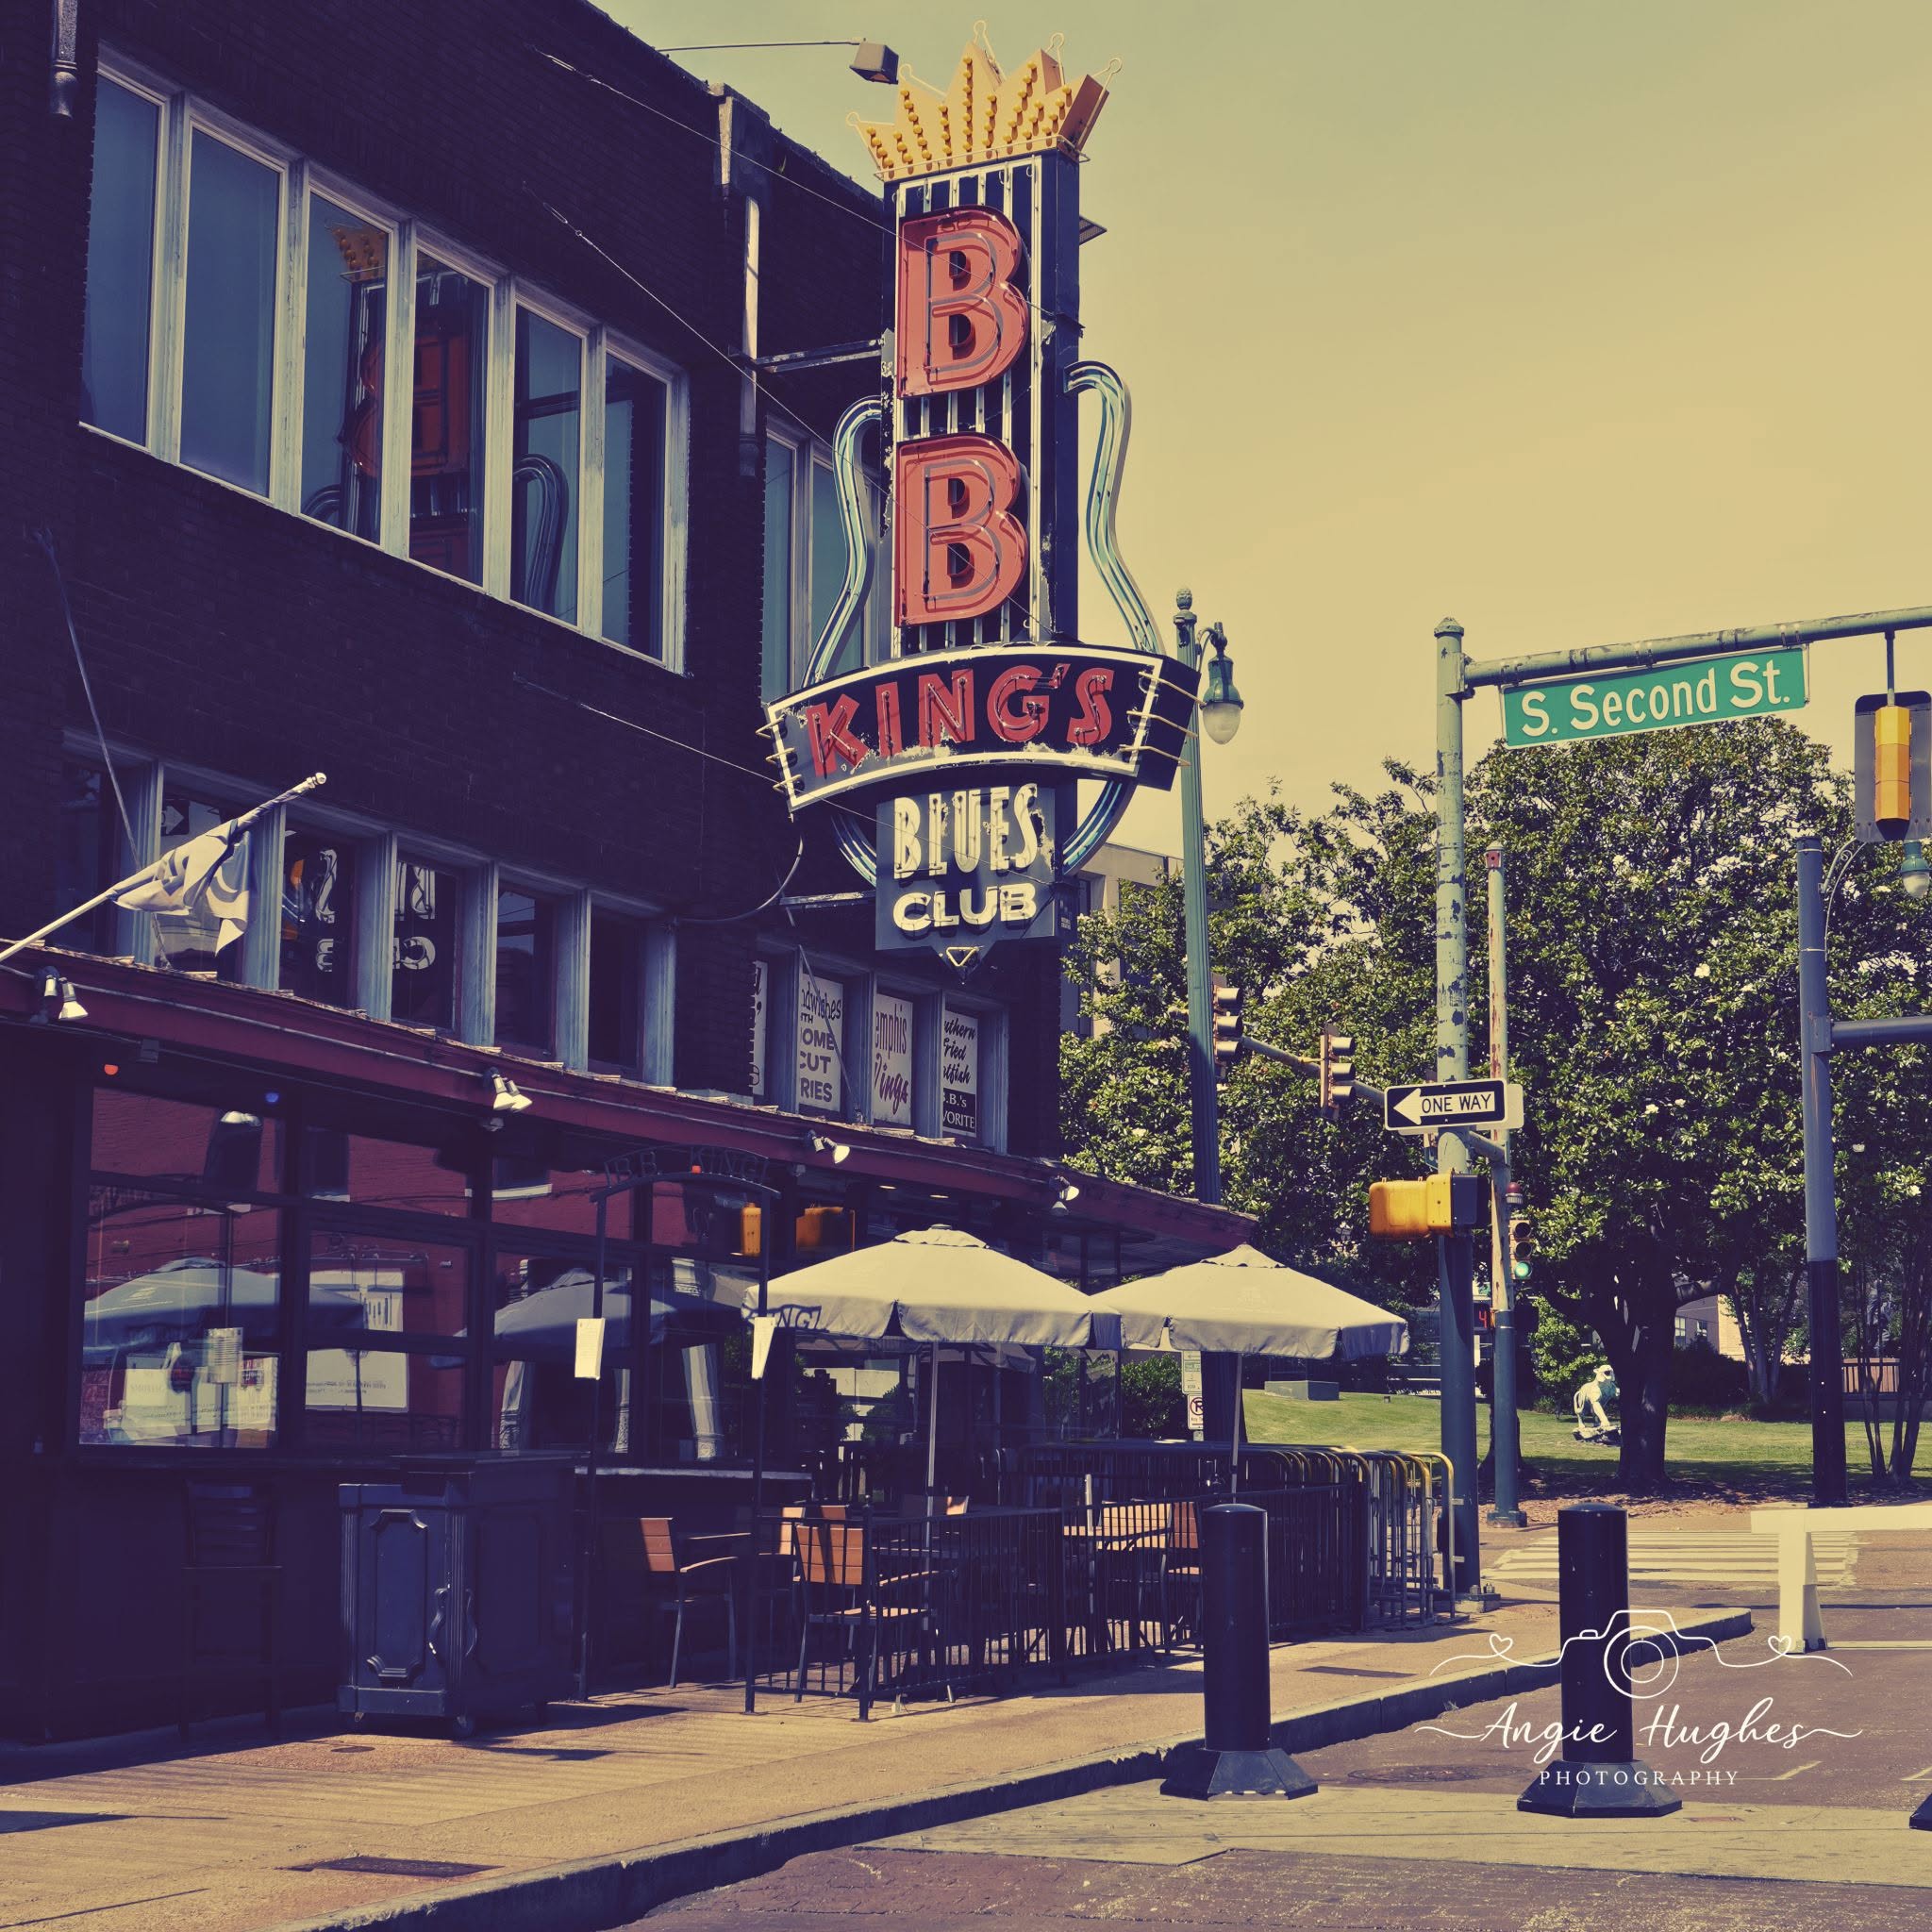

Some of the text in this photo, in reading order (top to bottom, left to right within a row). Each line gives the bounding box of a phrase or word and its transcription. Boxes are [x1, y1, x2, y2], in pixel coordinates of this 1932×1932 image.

[806, 662, 1115, 777] KING'S
[1521, 659, 1790, 737] S. Second St.
[893, 783, 1039, 879] BLUES
[892, 882, 1037, 932] CLUB
[801, 1026, 835, 1051] OME
[875, 1004, 907, 1059] emphis
[944, 1018, 975, 1041] uthern
[800, 1077, 832, 1103] RIES
[1422, 1093, 1491, 1114] ONE WAY
